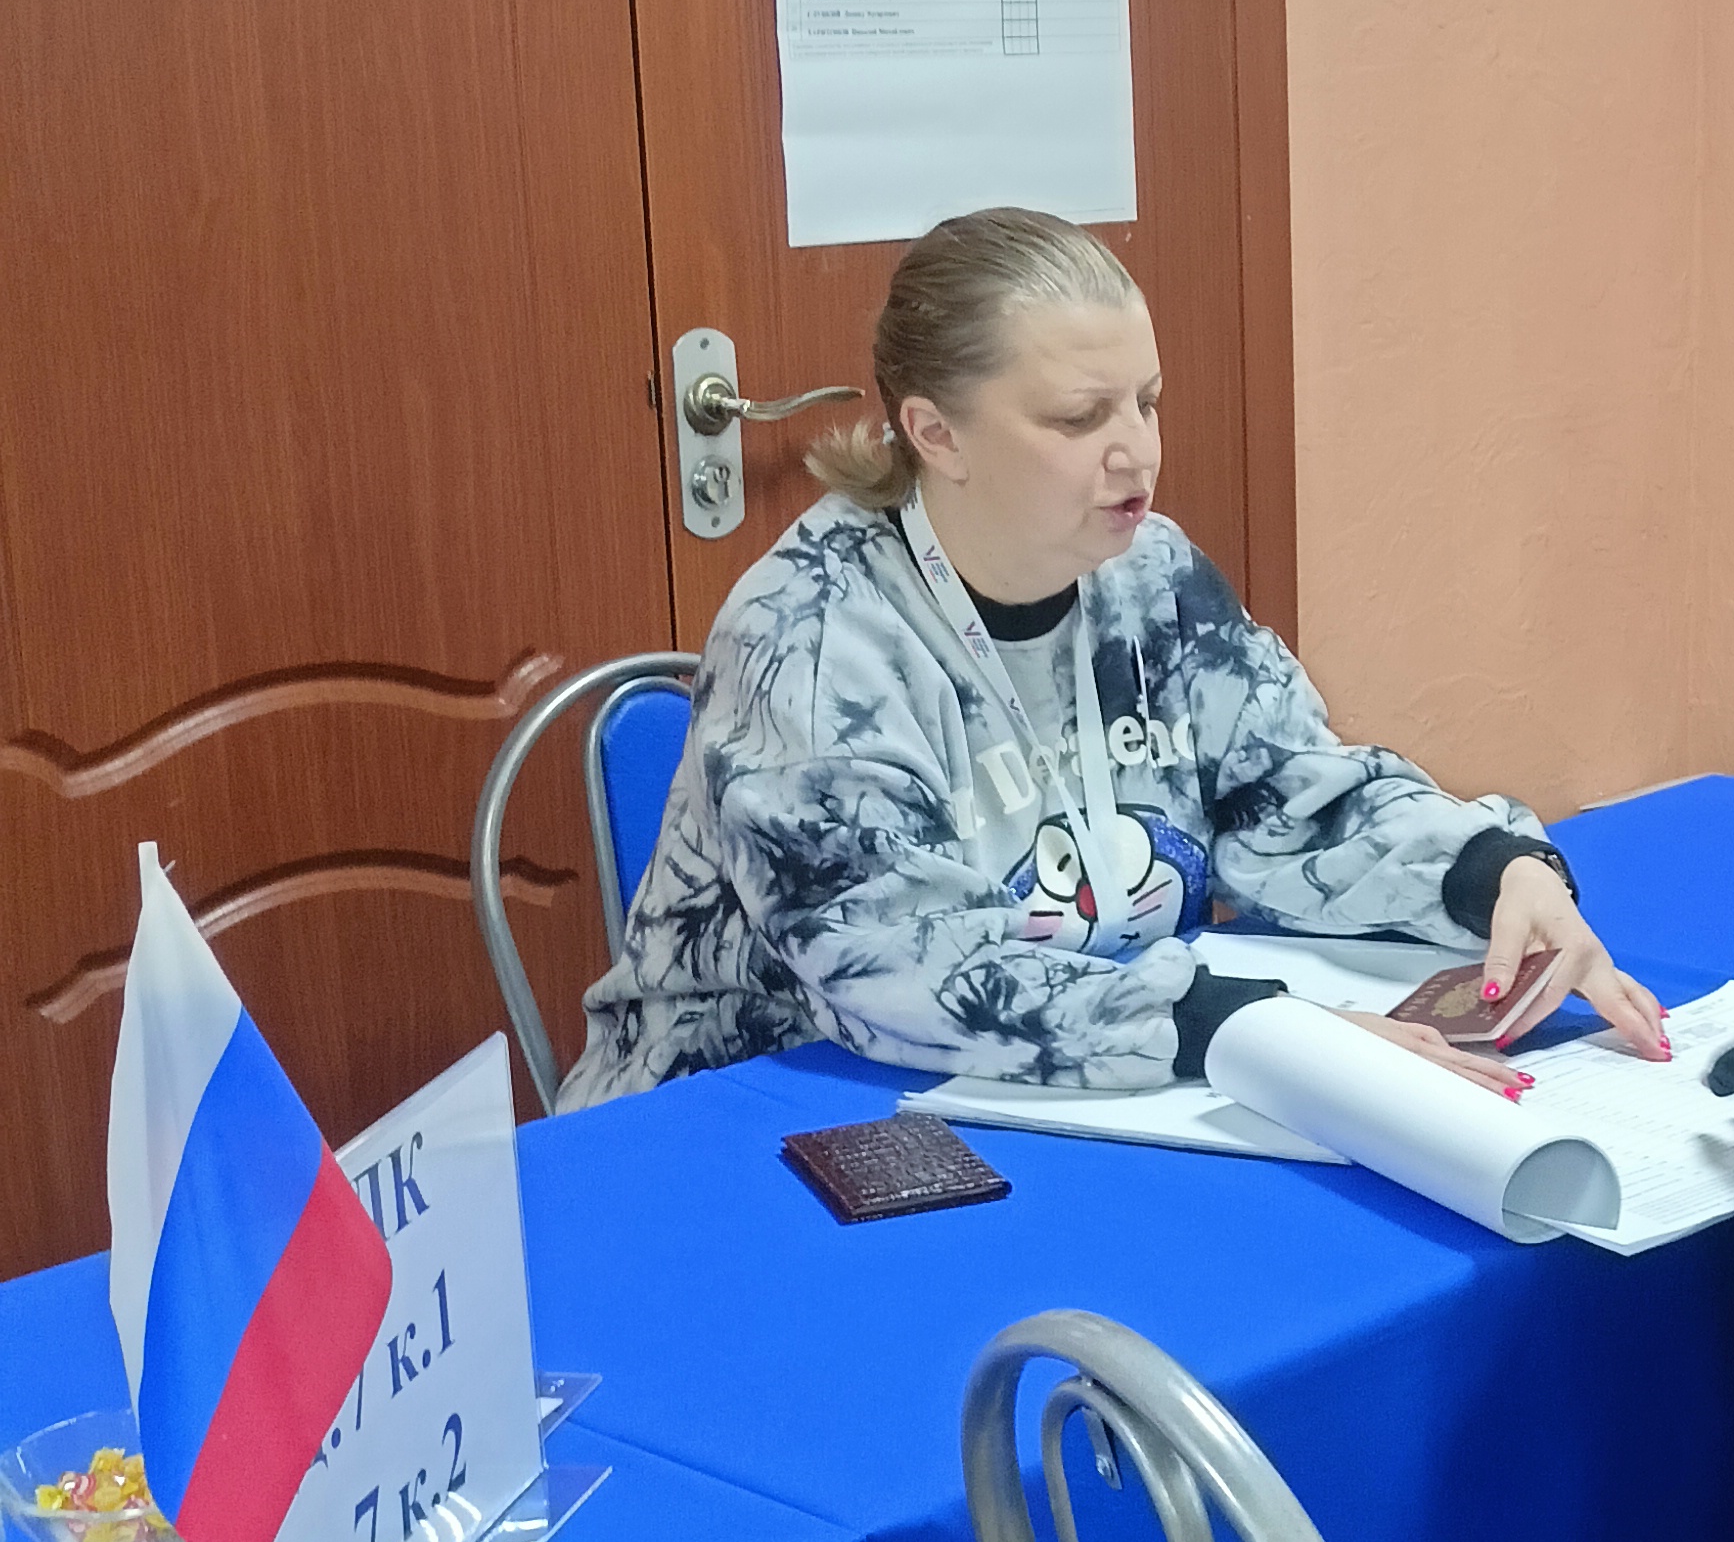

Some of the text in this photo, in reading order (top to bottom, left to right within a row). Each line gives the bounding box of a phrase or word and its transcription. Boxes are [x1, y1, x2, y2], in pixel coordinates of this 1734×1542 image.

[350, 1130, 431, 1245] ЛК
[385, 1267, 456, 1399] к.1
[398, 1412, 468, 1539] к.2
